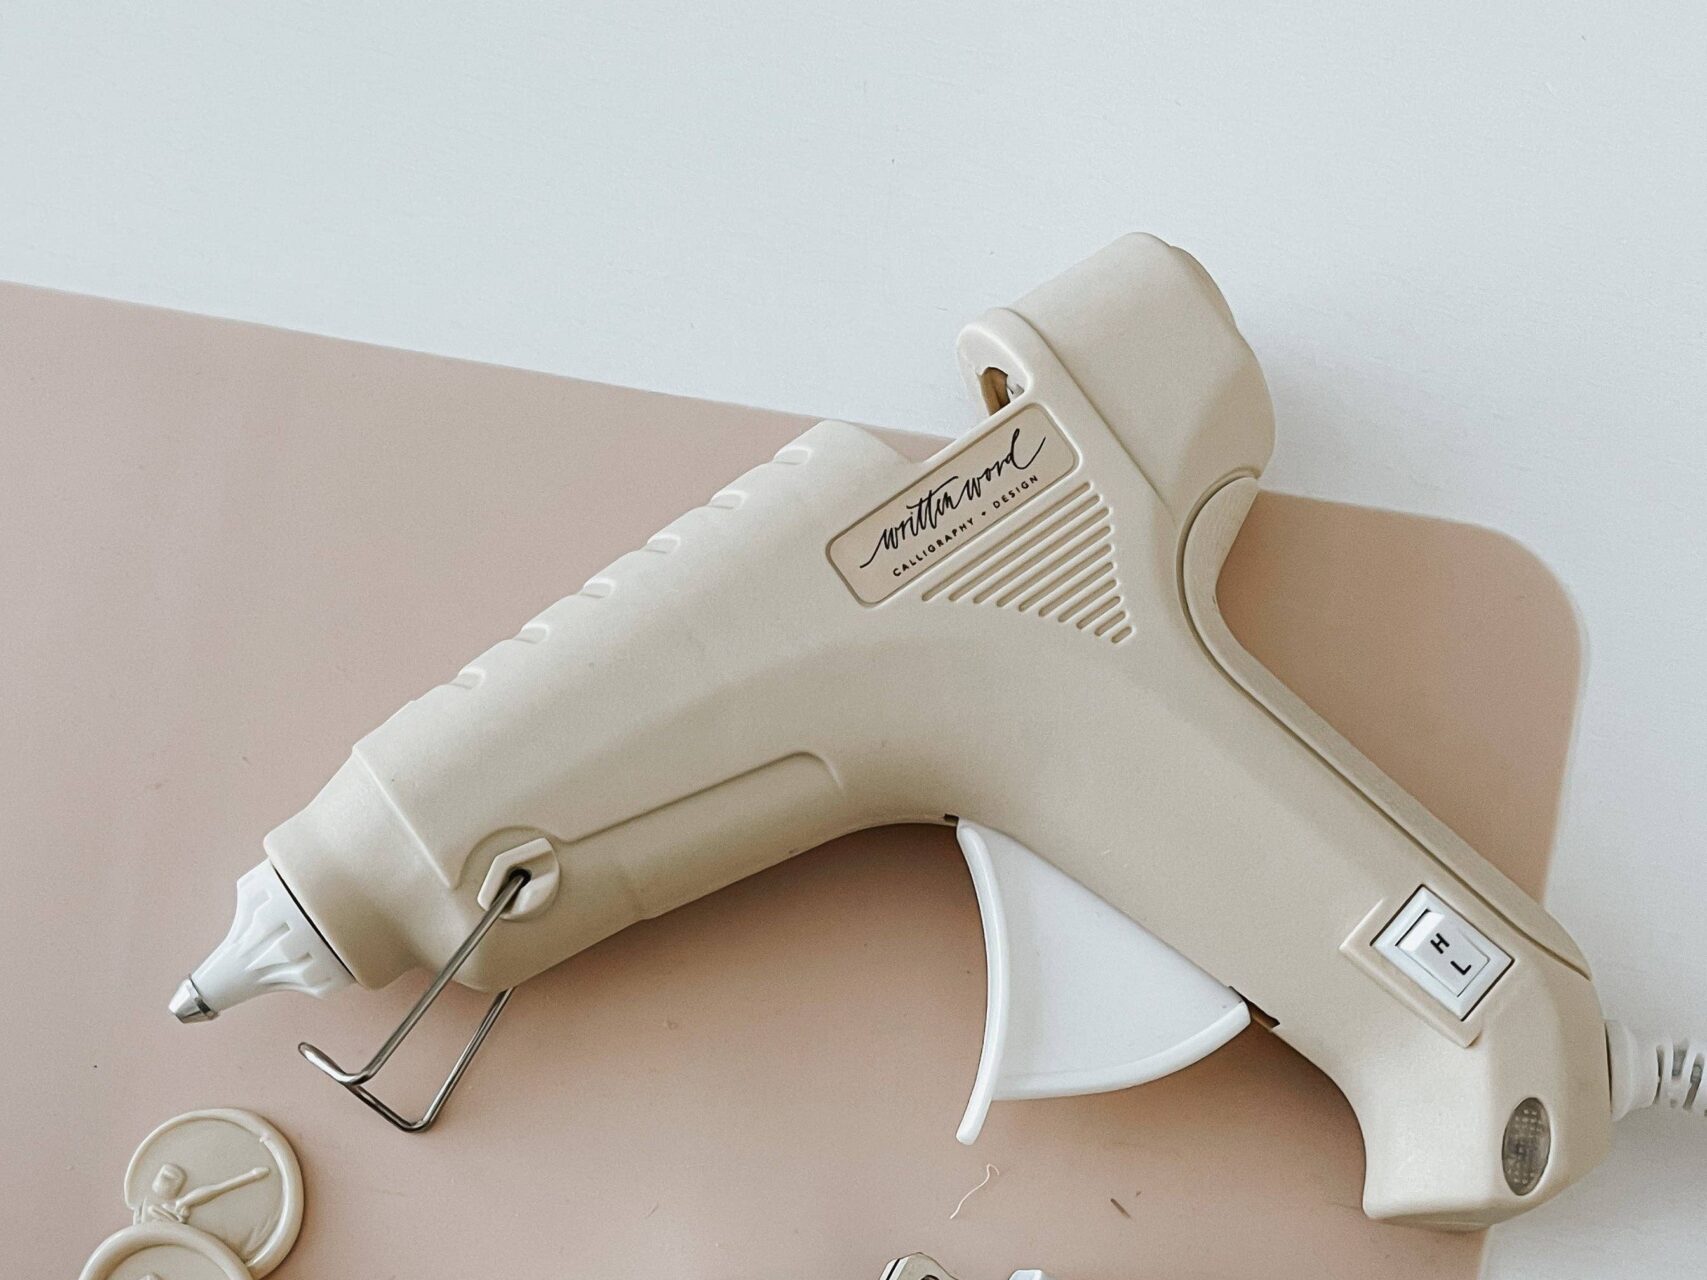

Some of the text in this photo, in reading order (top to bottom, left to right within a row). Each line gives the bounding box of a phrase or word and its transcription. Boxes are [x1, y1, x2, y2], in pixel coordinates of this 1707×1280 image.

[859, 427, 1047, 569] written word
[892, 474, 1038, 577] CALLIGRAPHY DESIGN
[1430, 933, 1450, 954] H
[1451, 960, 1472, 976] L
